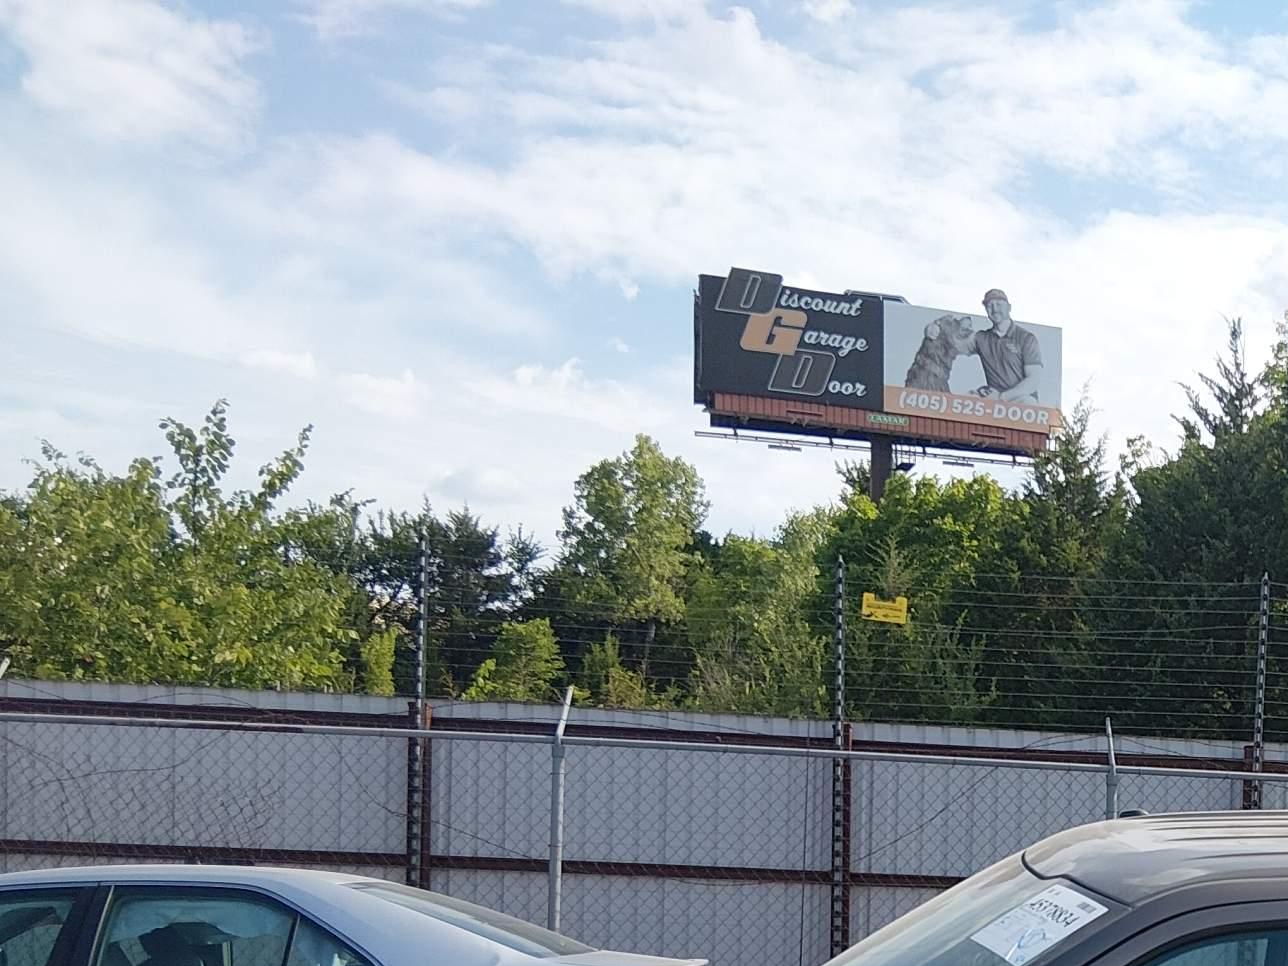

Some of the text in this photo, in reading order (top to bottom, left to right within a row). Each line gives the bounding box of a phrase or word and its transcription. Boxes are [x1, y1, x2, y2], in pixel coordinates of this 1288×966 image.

[714, 267, 863, 317] Discount
[739, 308, 869, 356] Garage
[767, 349, 868, 397] Door
[899, 390, 1050, 425] (405) 525-DOOR
